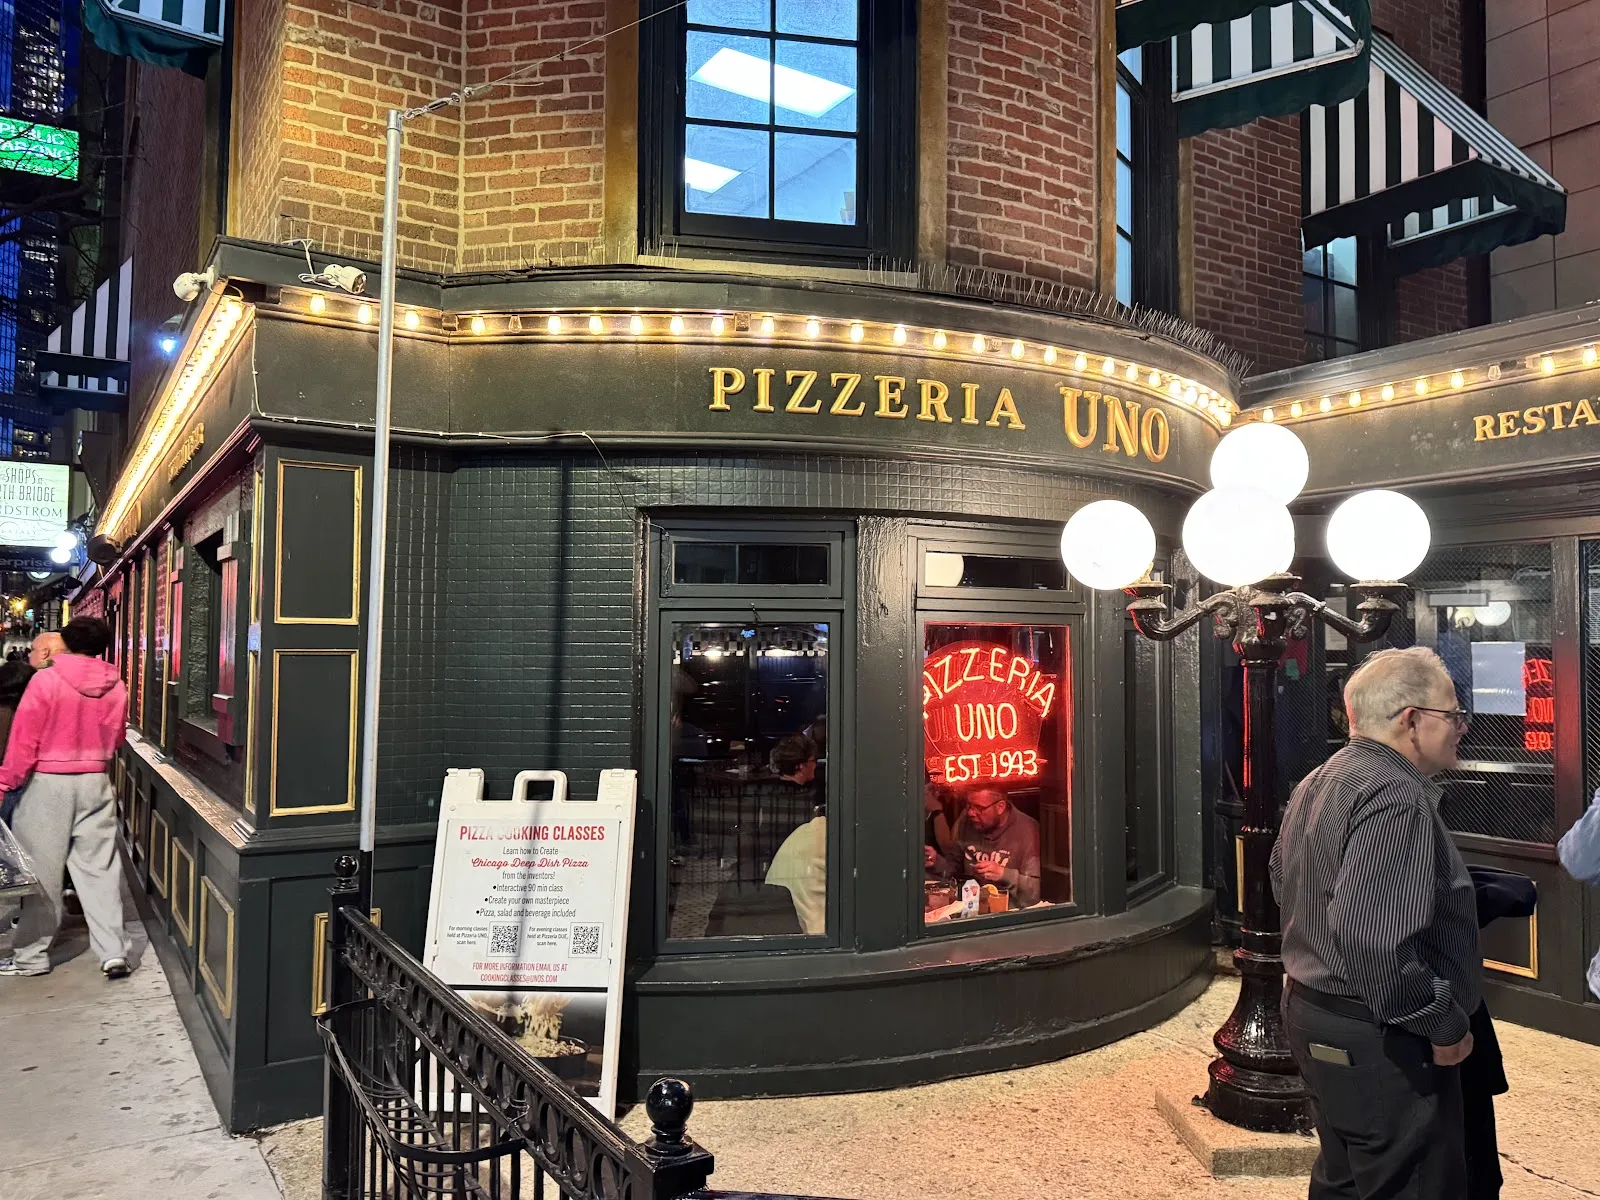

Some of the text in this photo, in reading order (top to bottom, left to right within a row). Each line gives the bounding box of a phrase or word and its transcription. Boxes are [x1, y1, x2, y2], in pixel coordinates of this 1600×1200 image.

[708, 367, 1170, 463] PIZZERIA UNO
[1473, 398, 1600, 442] RESTA
[5, 467, 36, 485] SHOPS
[0, 484, 56, 503] TH BRIDGE
[954, 702, 1018, 742] UNO
[945, 749, 1039, 783] EST 1943
[459, 825, 493, 841] PIZZA
[553, 825, 605, 841] CLASSES
[502, 846, 559, 855] Learn how to Create
[471, 857, 589, 870] Chicago Deep Dish Pizza
[502, 871, 556, 880] from the inventors!
[496, 883, 563, 892] Interactive 90 min class
[488, 896, 570, 906] Create your own masterpiece
[479, 907, 576, 919] Pizza, salad and beverage included
[472, 962, 568, 972] FOR MORE INFORMATION EMAIL US AT
